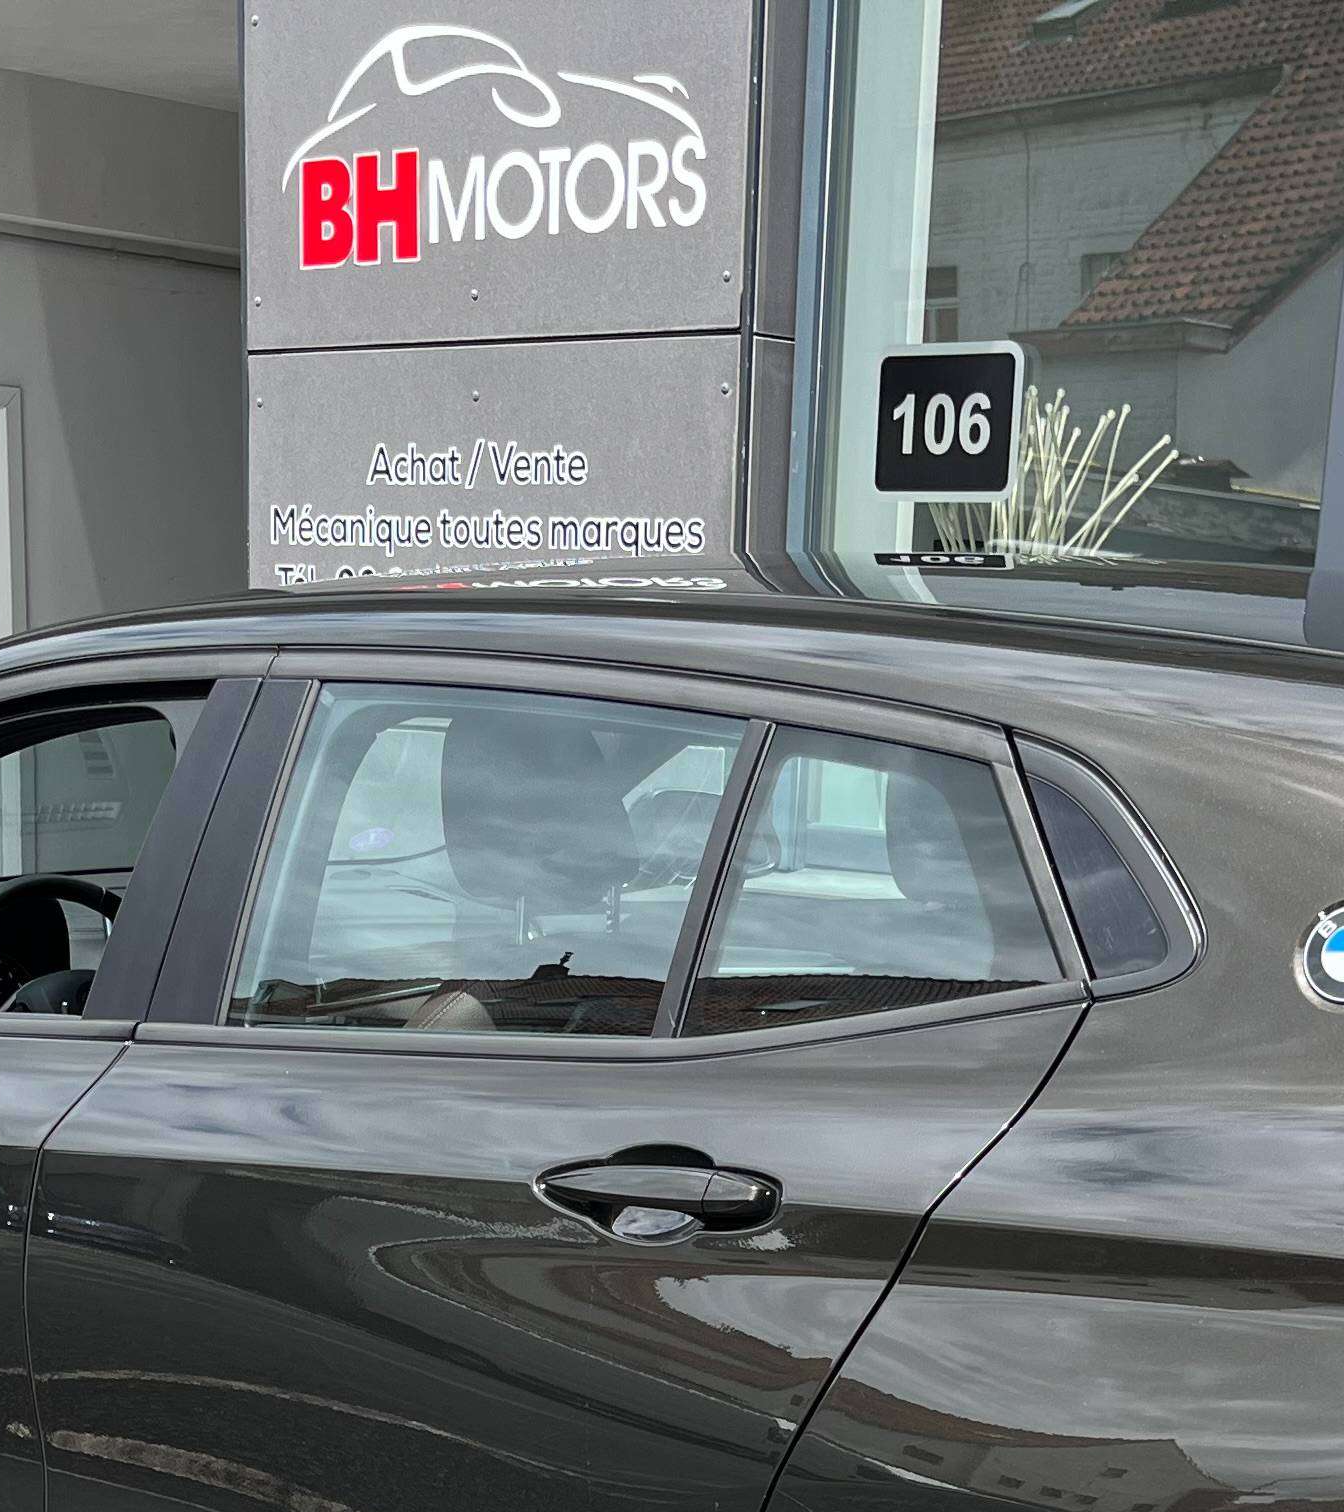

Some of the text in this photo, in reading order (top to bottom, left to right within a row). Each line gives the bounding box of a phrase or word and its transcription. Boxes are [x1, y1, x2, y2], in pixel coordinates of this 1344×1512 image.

[299, 135, 707, 270] BH MOTORS
[892, 392, 992, 456] 106
[366, 442, 463, 486] Achat
[488, 442, 588, 485] Vente
[270, 504, 705, 556] Mécanique toutes marques
